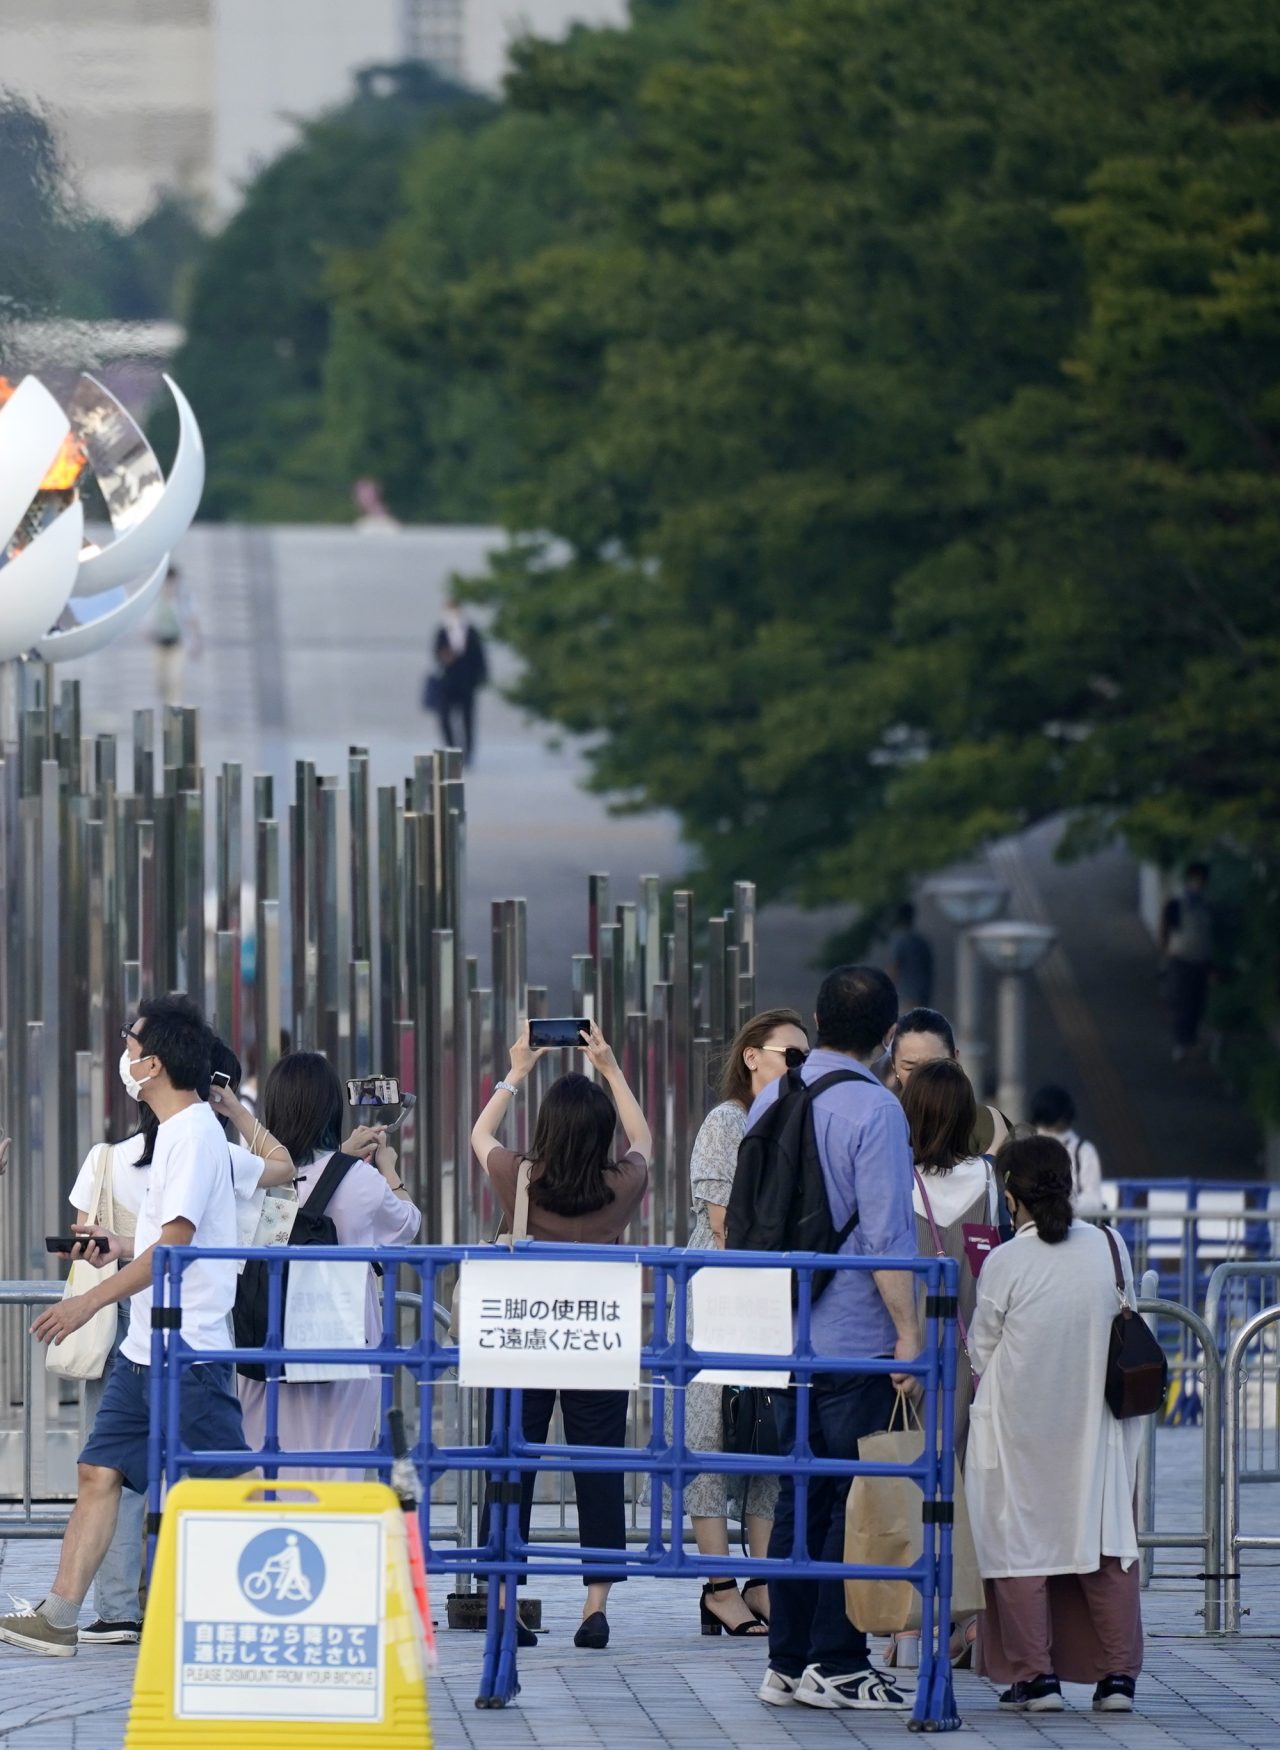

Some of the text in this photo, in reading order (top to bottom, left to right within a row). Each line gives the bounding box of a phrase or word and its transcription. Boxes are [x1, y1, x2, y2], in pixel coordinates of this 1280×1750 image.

[480, 1298, 621, 1322] 三脚の使用は
[478, 1327, 622, 1351] ご遠慮ください
[195, 1624, 367, 1645] 自転車から降りて
[194, 1644, 367, 1665] 通行してください
[186, 1668, 373, 1685] PLEASE DISMOUNT FROM YOUR BICYCLE
